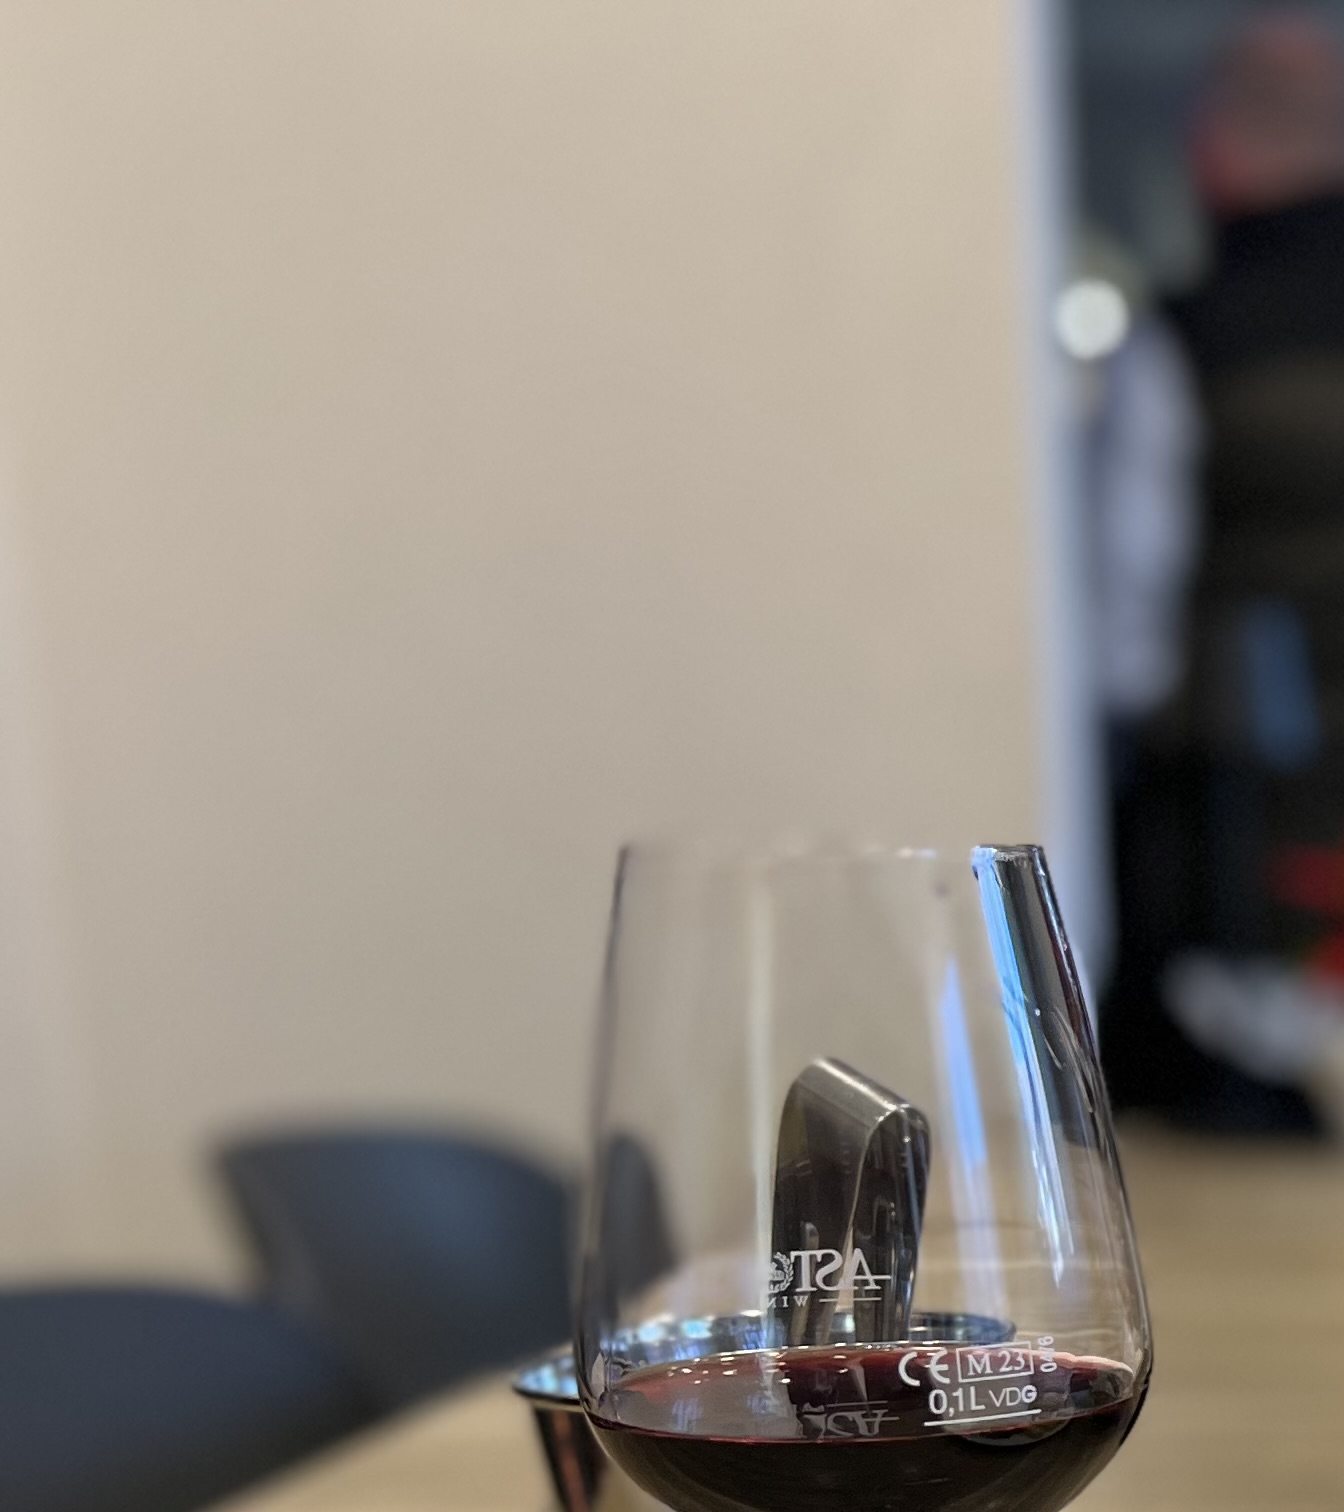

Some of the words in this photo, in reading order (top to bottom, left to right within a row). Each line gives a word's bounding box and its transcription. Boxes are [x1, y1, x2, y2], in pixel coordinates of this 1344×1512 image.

[897, 1349, 951, 1387] CE
[966, 1352, 993, 1376] M
[999, 1350, 1026, 1372] 23
[988, 1384, 1038, 1408] VDG
